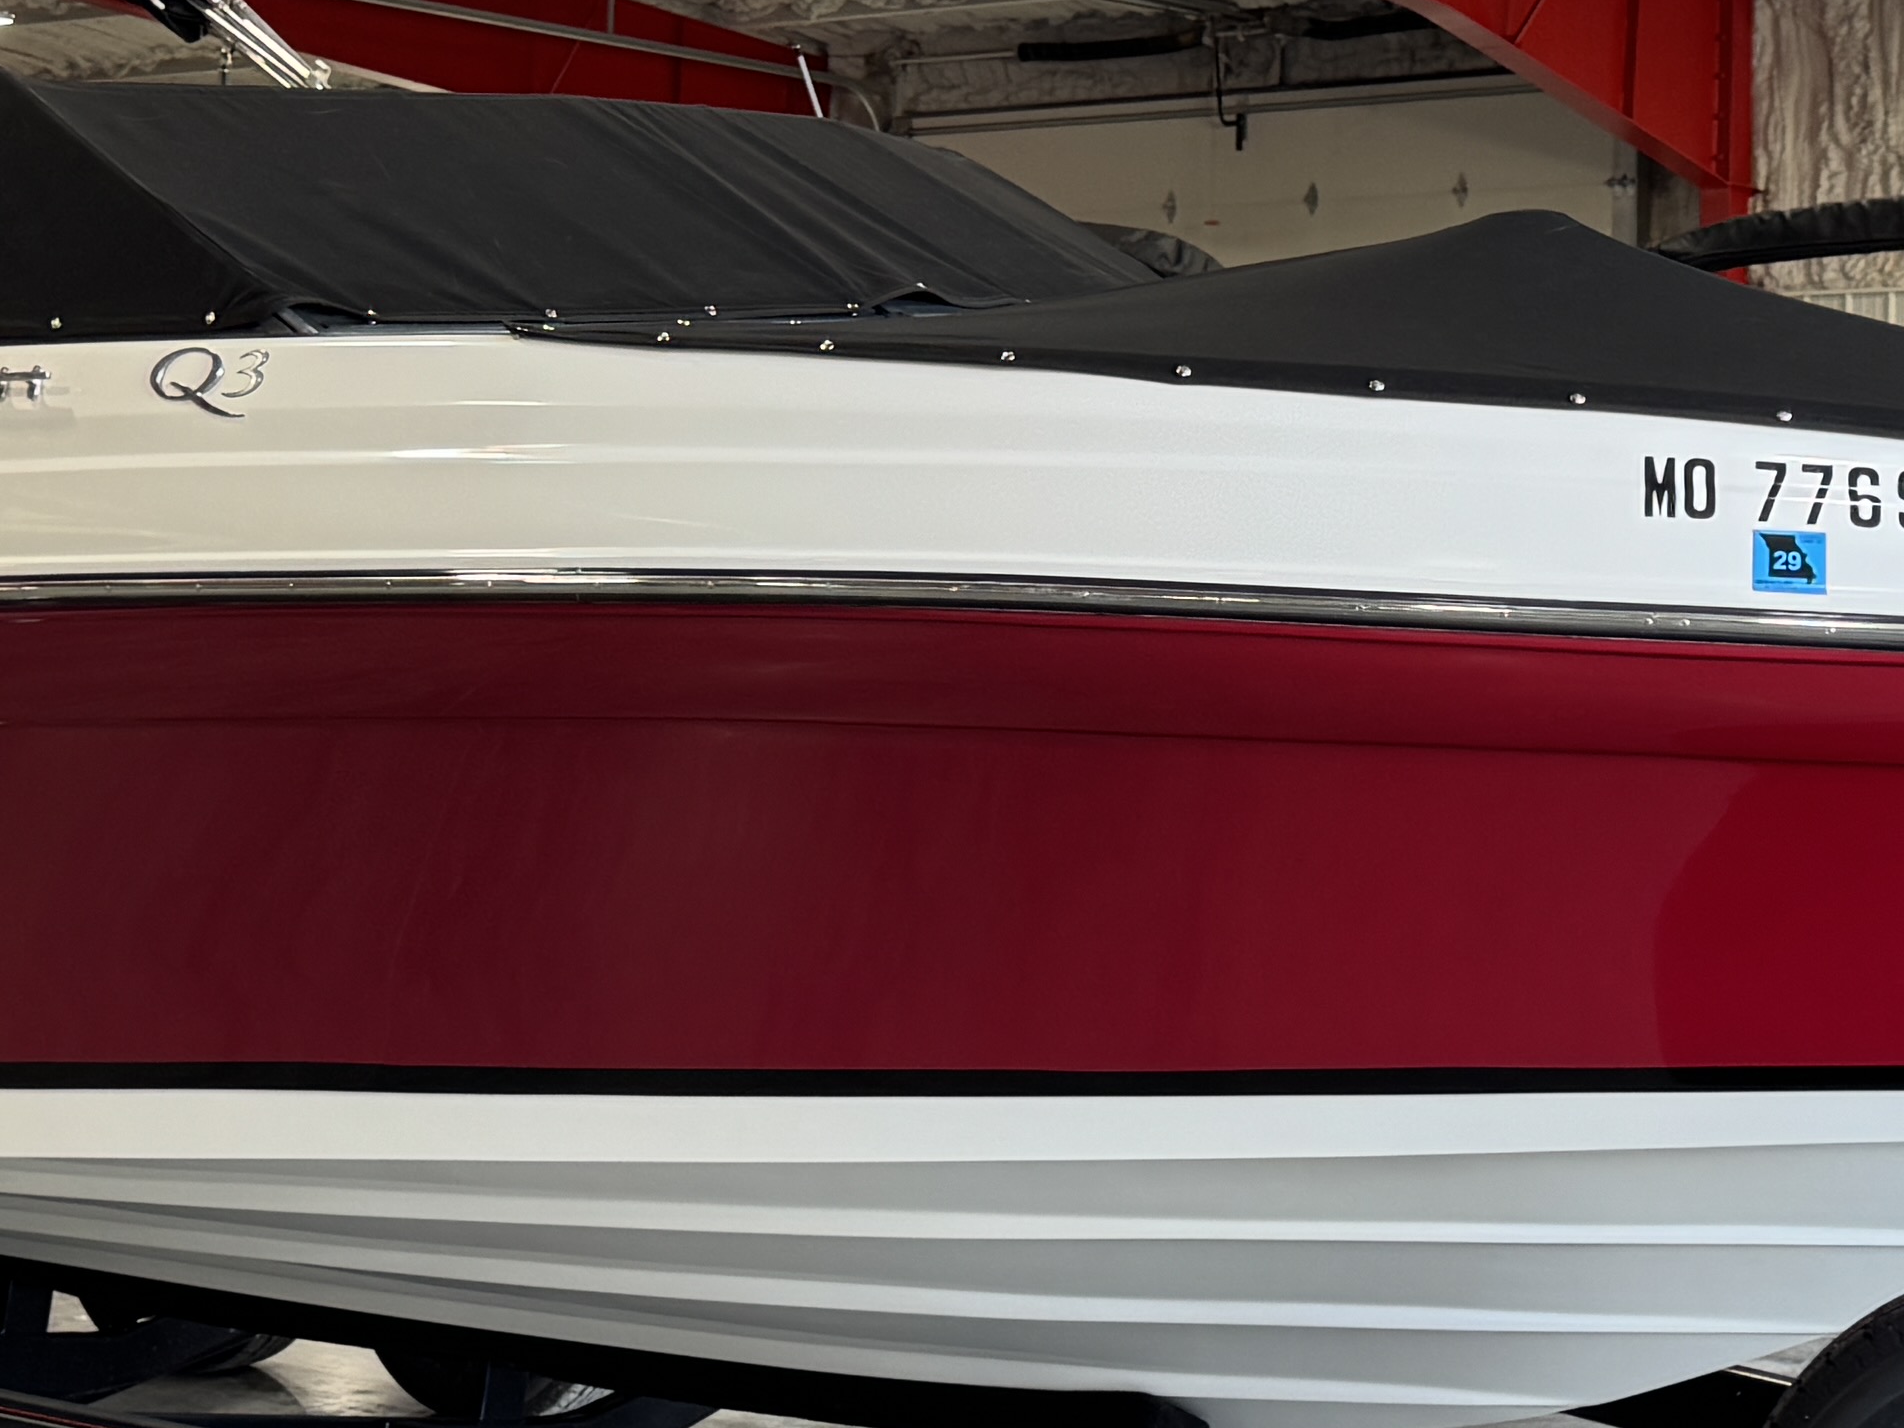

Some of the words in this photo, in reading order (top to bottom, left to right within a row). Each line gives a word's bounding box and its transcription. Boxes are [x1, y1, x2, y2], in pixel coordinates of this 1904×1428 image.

[150, 346, 270, 418] Q3
[1644, 456, 1716, 519] MO
[1772, 550, 1802, 571] 29
